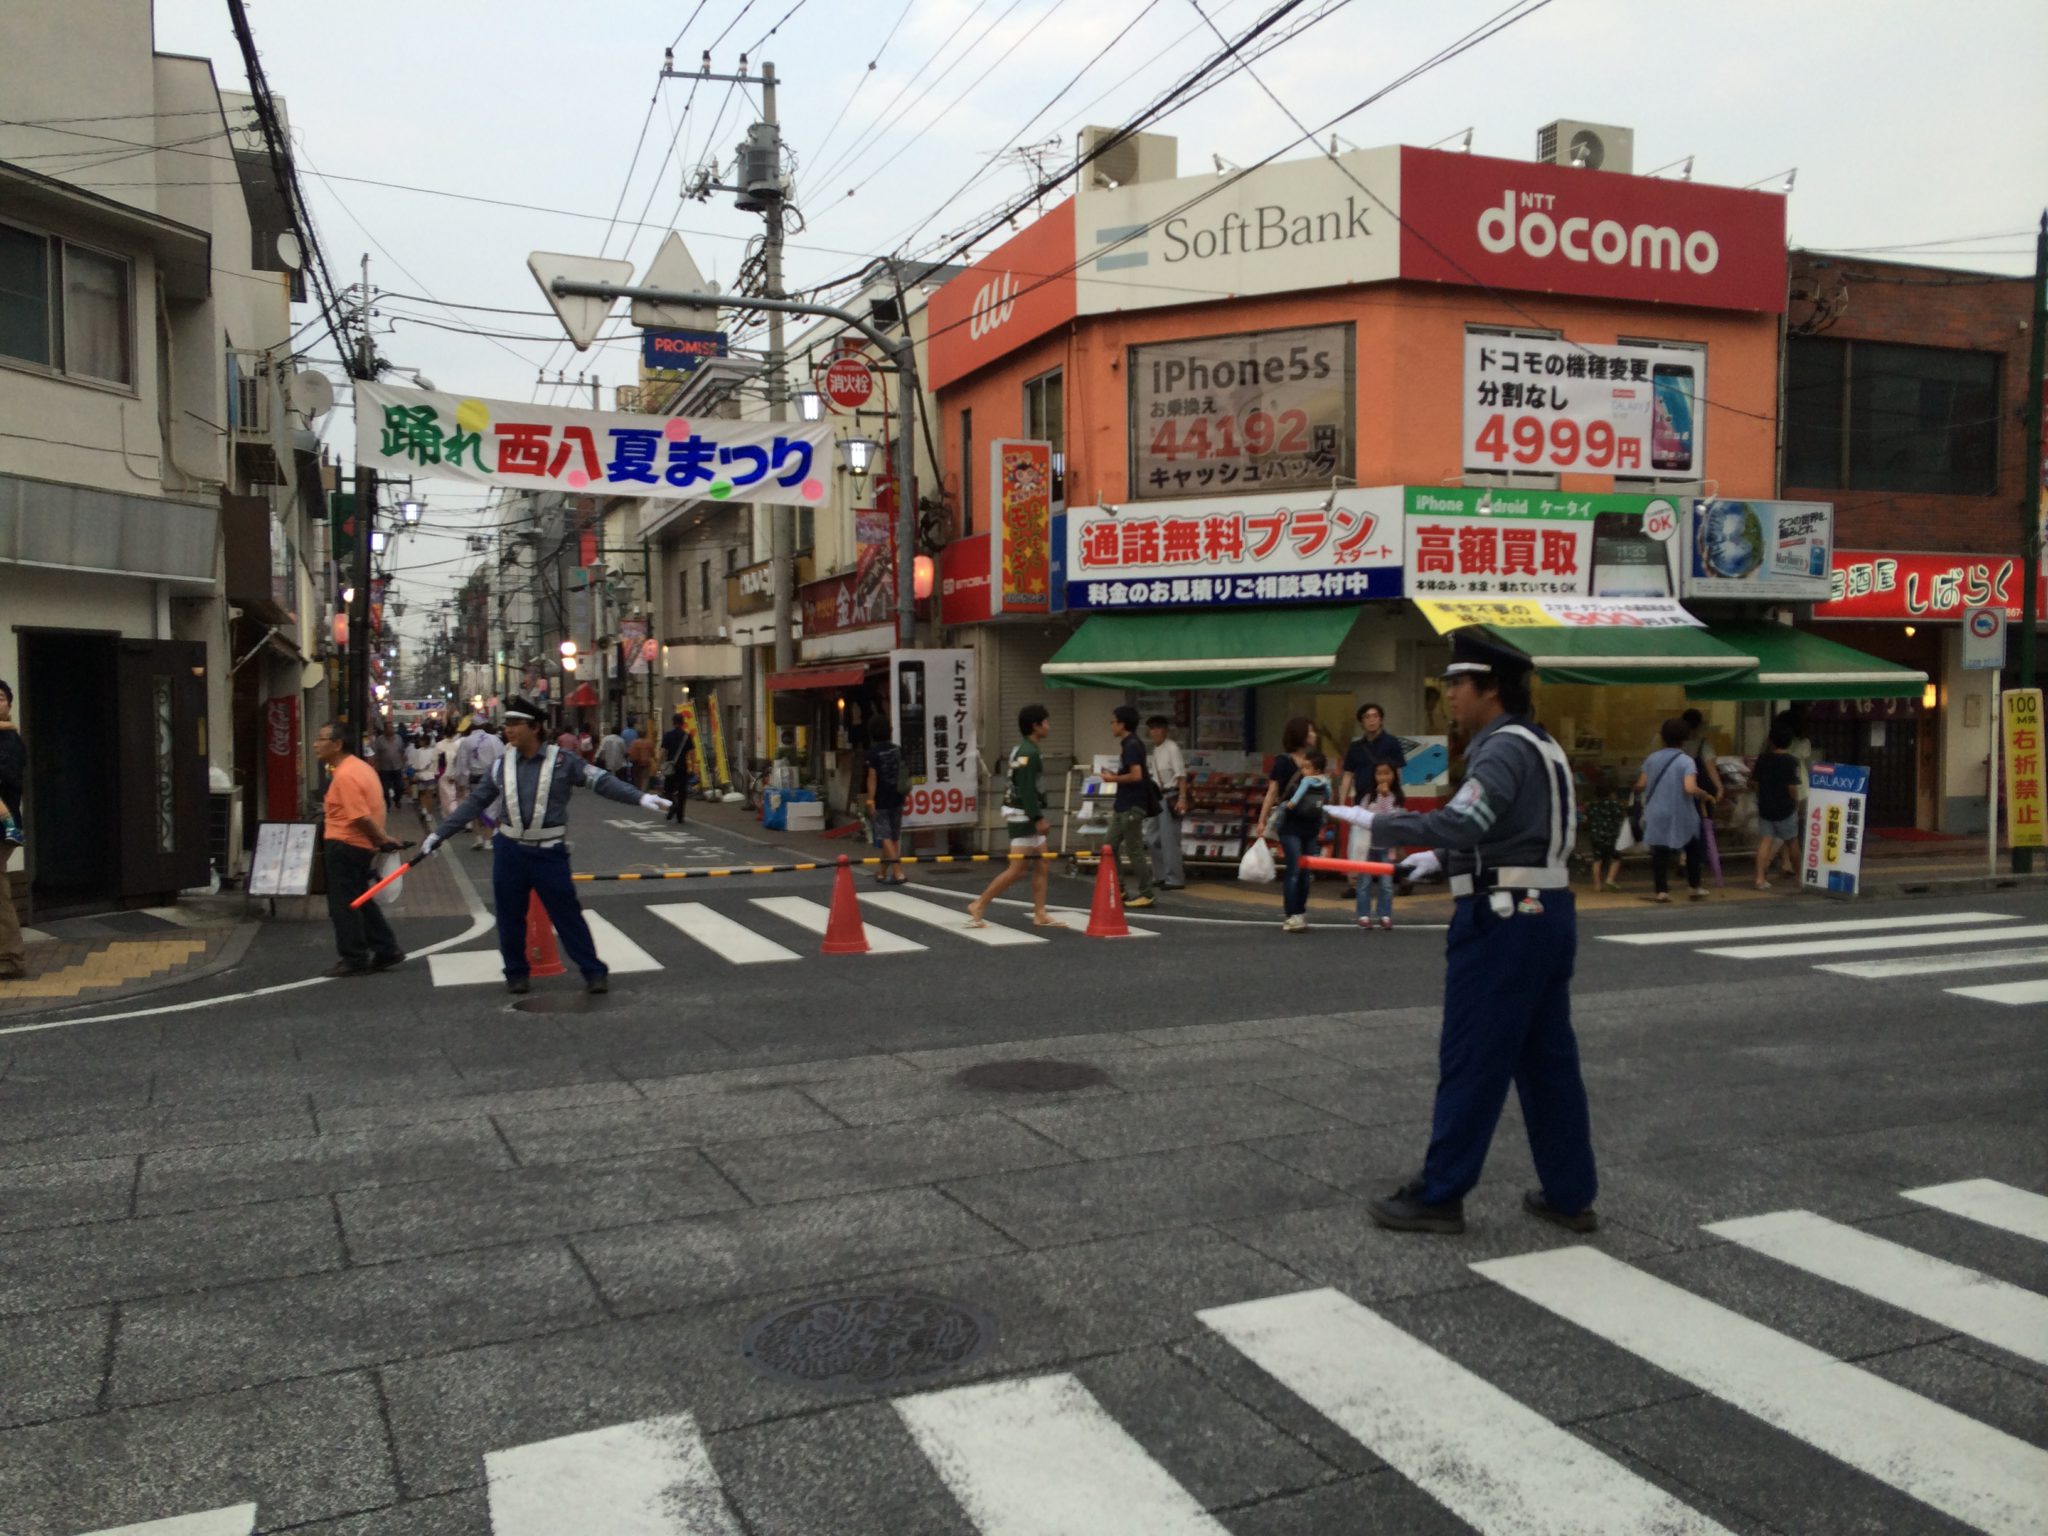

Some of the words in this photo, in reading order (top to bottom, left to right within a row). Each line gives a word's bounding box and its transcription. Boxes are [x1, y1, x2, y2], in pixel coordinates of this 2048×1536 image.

[1520, 191, 1556, 211] NTT
[1162, 196, 1373, 264] SoftBank
[1477, 189, 1720, 275] docomo
[969, 270, 1020, 342] au
[829, 373, 871, 394] 消火栓
[1152, 346, 1331, 394] iPhone5s
[1478, 345, 1650, 384] ドコモの機種変更
[1150, 396, 1218, 418] お乗換え
[1477, 379, 1570, 411] 分割なし
[1474, 414, 1641, 470] 4999円
[1149, 448, 1337, 490] キャッシュバック
[1415, 494, 1464, 512] iPhone
[1475, 497, 1529, 514] Adroid
[1540, 500, 1592, 517] ケータイ
[1648, 514, 1673, 534] OK
[1081, 508, 1379, 569] 通話無料プラン
[1333, 546, 1393, 565] スタート
[1416, 524, 1578, 576] 高額買取
[1088, 572, 1369, 605] 料金のお見積りご相談受付中
[1906, 560, 2014, 615] しばらく
[953, 659, 968, 773] ドコモケータイ
[2008, 695, 2037, 714] 100
[933, 715, 950, 784] 機種変更
[1811, 773, 1855, 790] GALAXY
[2012, 729, 2041, 826] 右折禁止
[1805, 806, 1823, 884] 4999円
[1825, 806, 1842, 864] 分割なし
